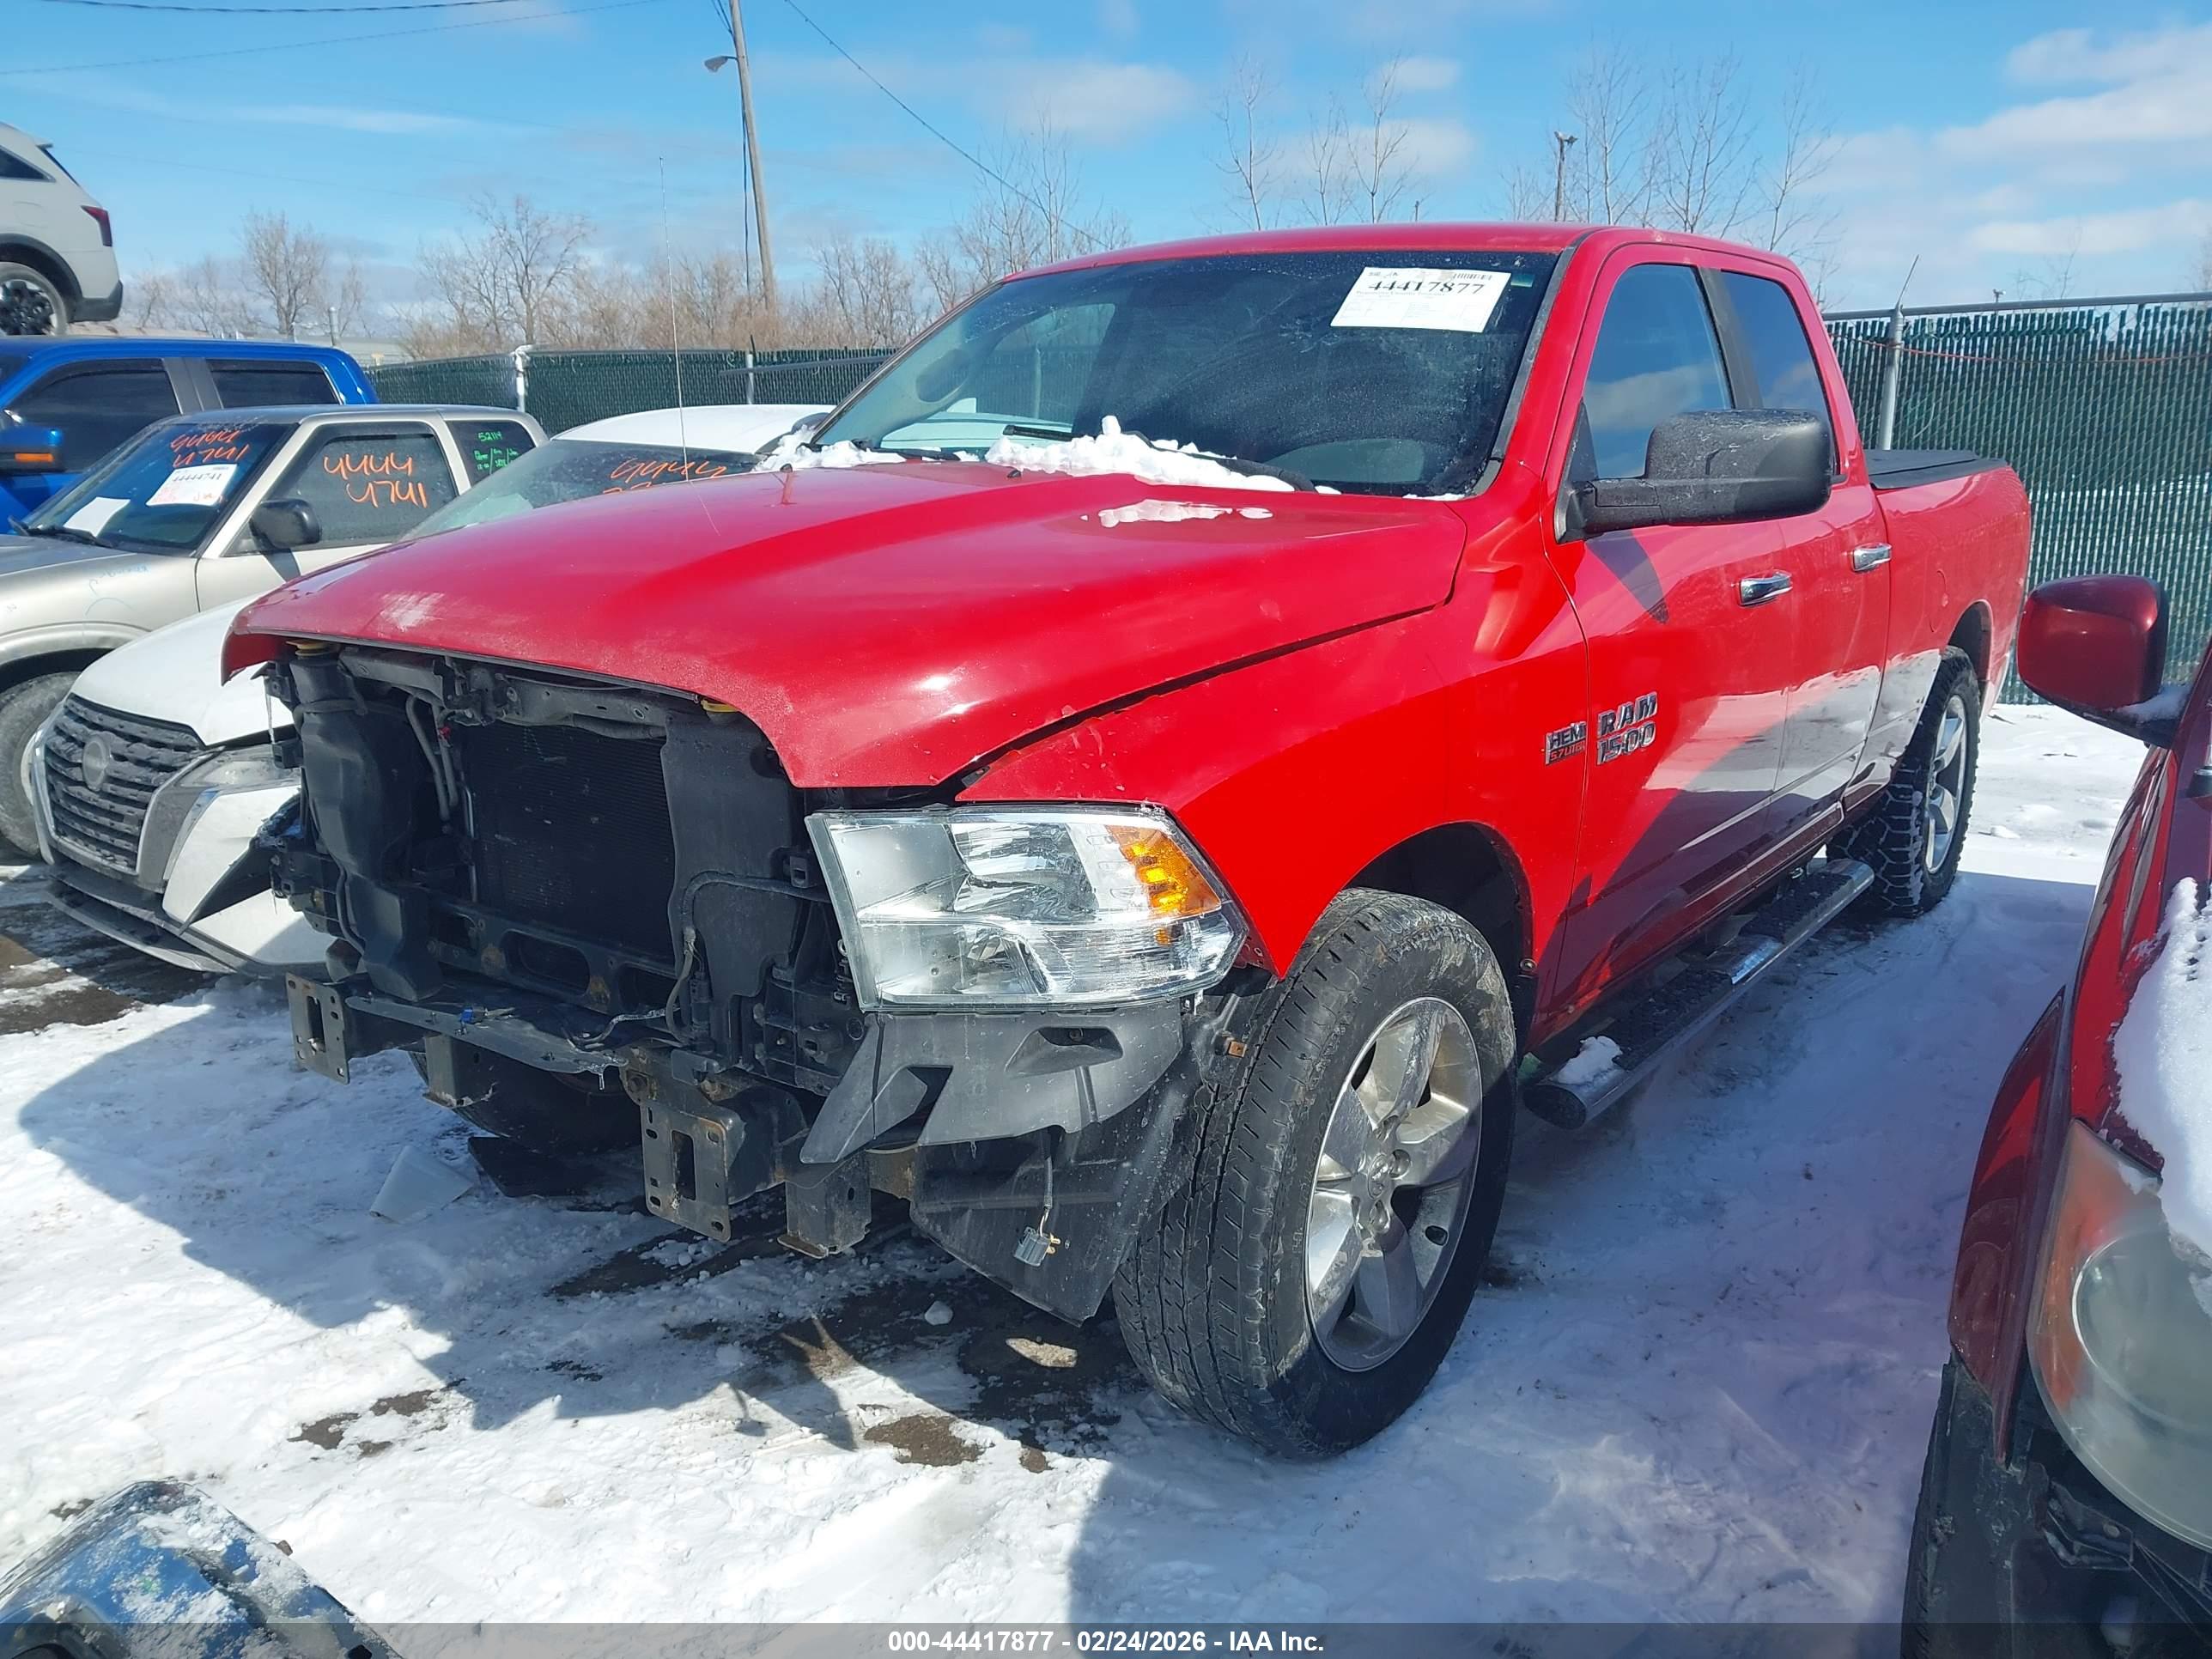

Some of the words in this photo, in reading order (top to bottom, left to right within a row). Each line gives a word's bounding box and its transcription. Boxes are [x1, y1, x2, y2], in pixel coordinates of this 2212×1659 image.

[1369, 280, 1486, 295] 44417877
[324, 452, 413, 480] 4444
[346, 480, 428, 508] 4741
[1597, 691, 1657, 738] RAM
[1597, 721, 1656, 765] 1500
